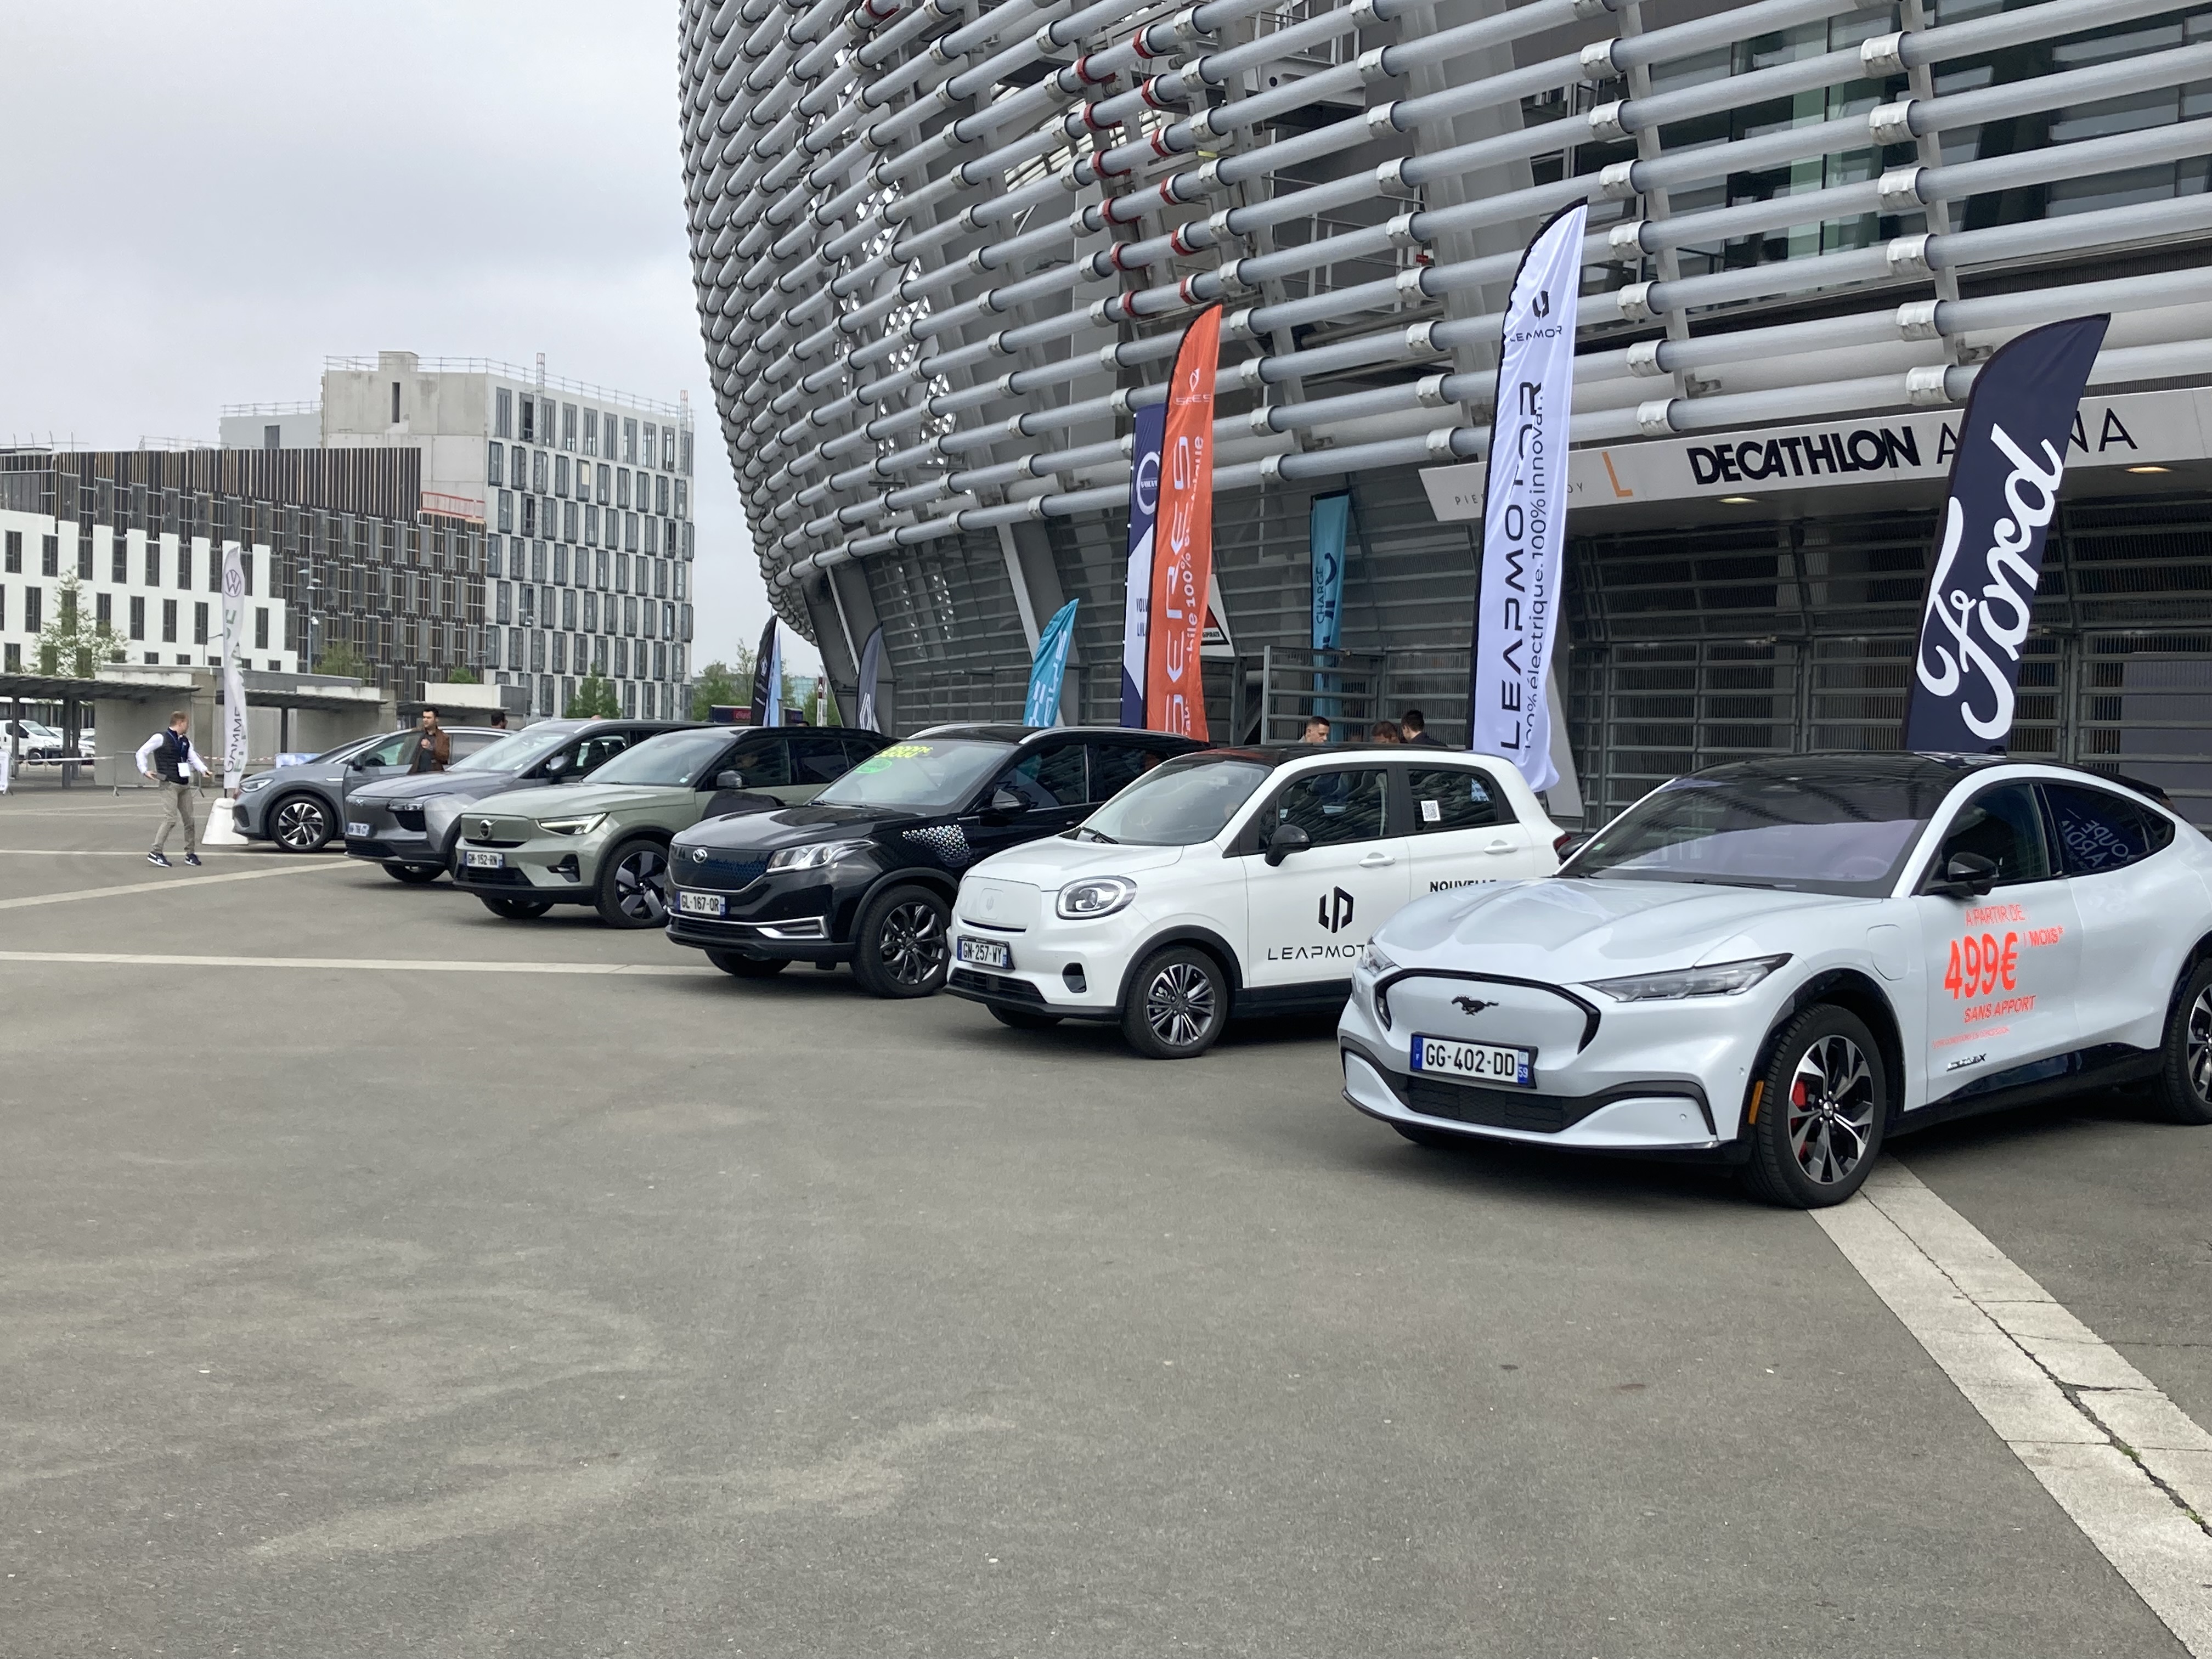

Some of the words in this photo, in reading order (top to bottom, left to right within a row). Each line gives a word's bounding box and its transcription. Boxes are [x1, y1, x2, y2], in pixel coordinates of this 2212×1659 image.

[1686, 425, 1921, 485] DECATHLON
[1530, 499, 1547, 560] 100%
[1180, 552, 1197, 608] 100%
[1316, 565, 1325, 625] CHARGE
[1916, 422, 2064, 740] Ford
[963, 942, 1002, 964] GN-257-WY
[1268, 944, 1365, 961] LEAPMOT
[1944, 932, 2019, 1000] 499€
[1964, 1003, 1991, 1023] SANS
[1994, 994, 2037, 1016] APPORT
[1426, 1043, 1515, 1076] GG-402-DD
[1518, 1066, 1528, 1079] 59
